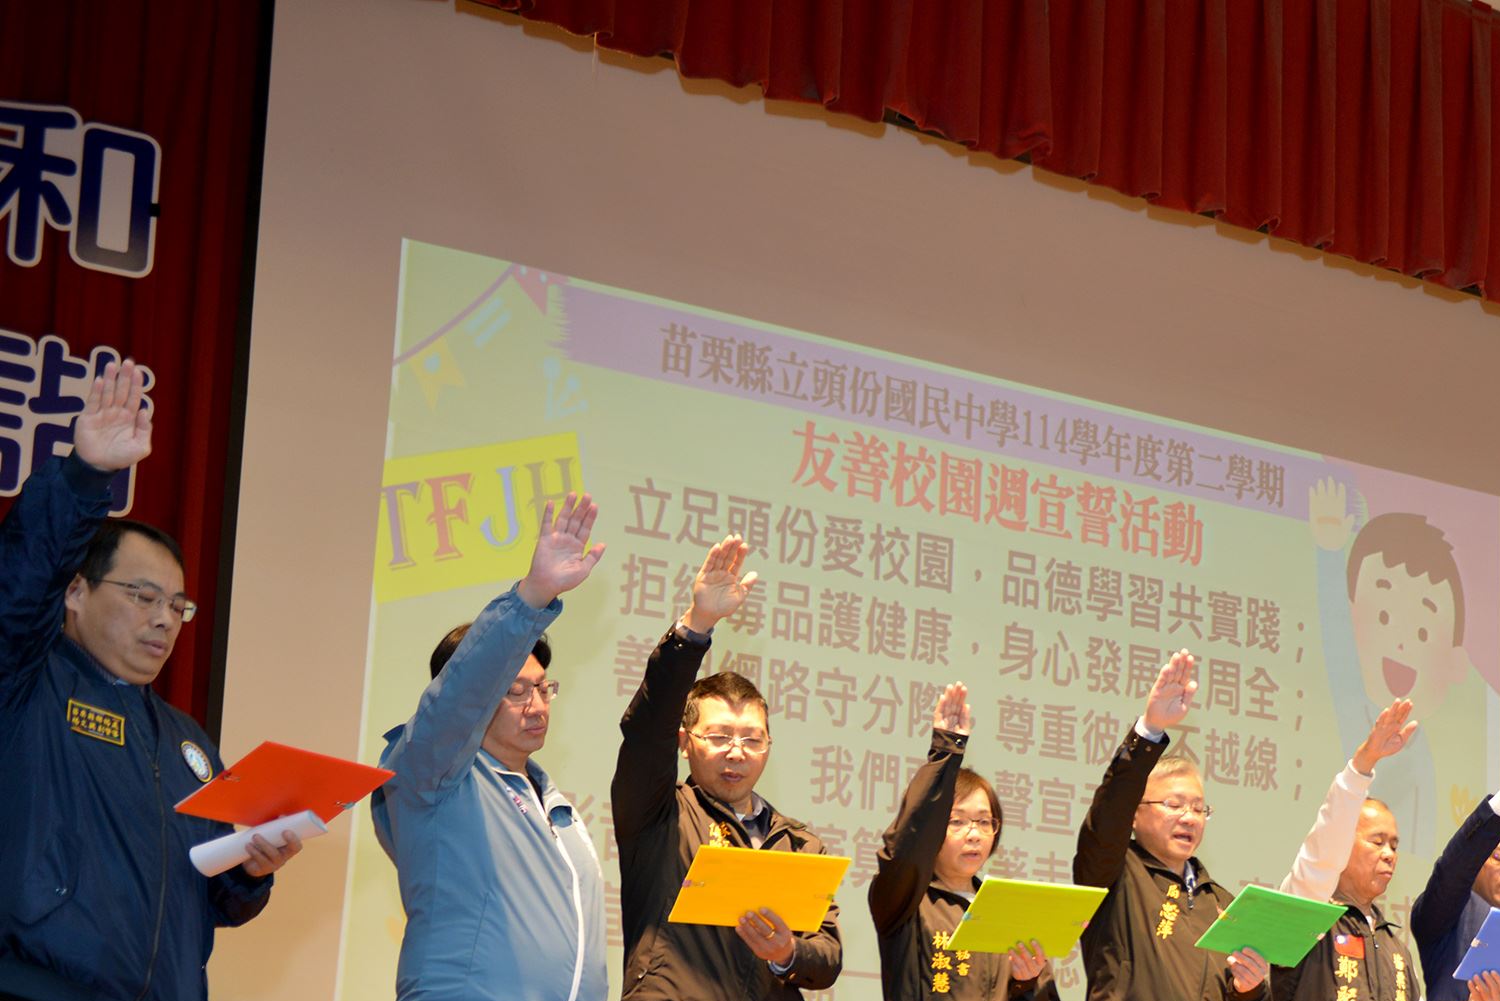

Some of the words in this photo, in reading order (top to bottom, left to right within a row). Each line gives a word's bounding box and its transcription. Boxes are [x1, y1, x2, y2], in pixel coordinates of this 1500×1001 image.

[660, 322, 1286, 510] 苗栗縣立頭份國民中學114學年度第二學期
[791, 420, 1204, 567] 友善校園週宣誓活動
